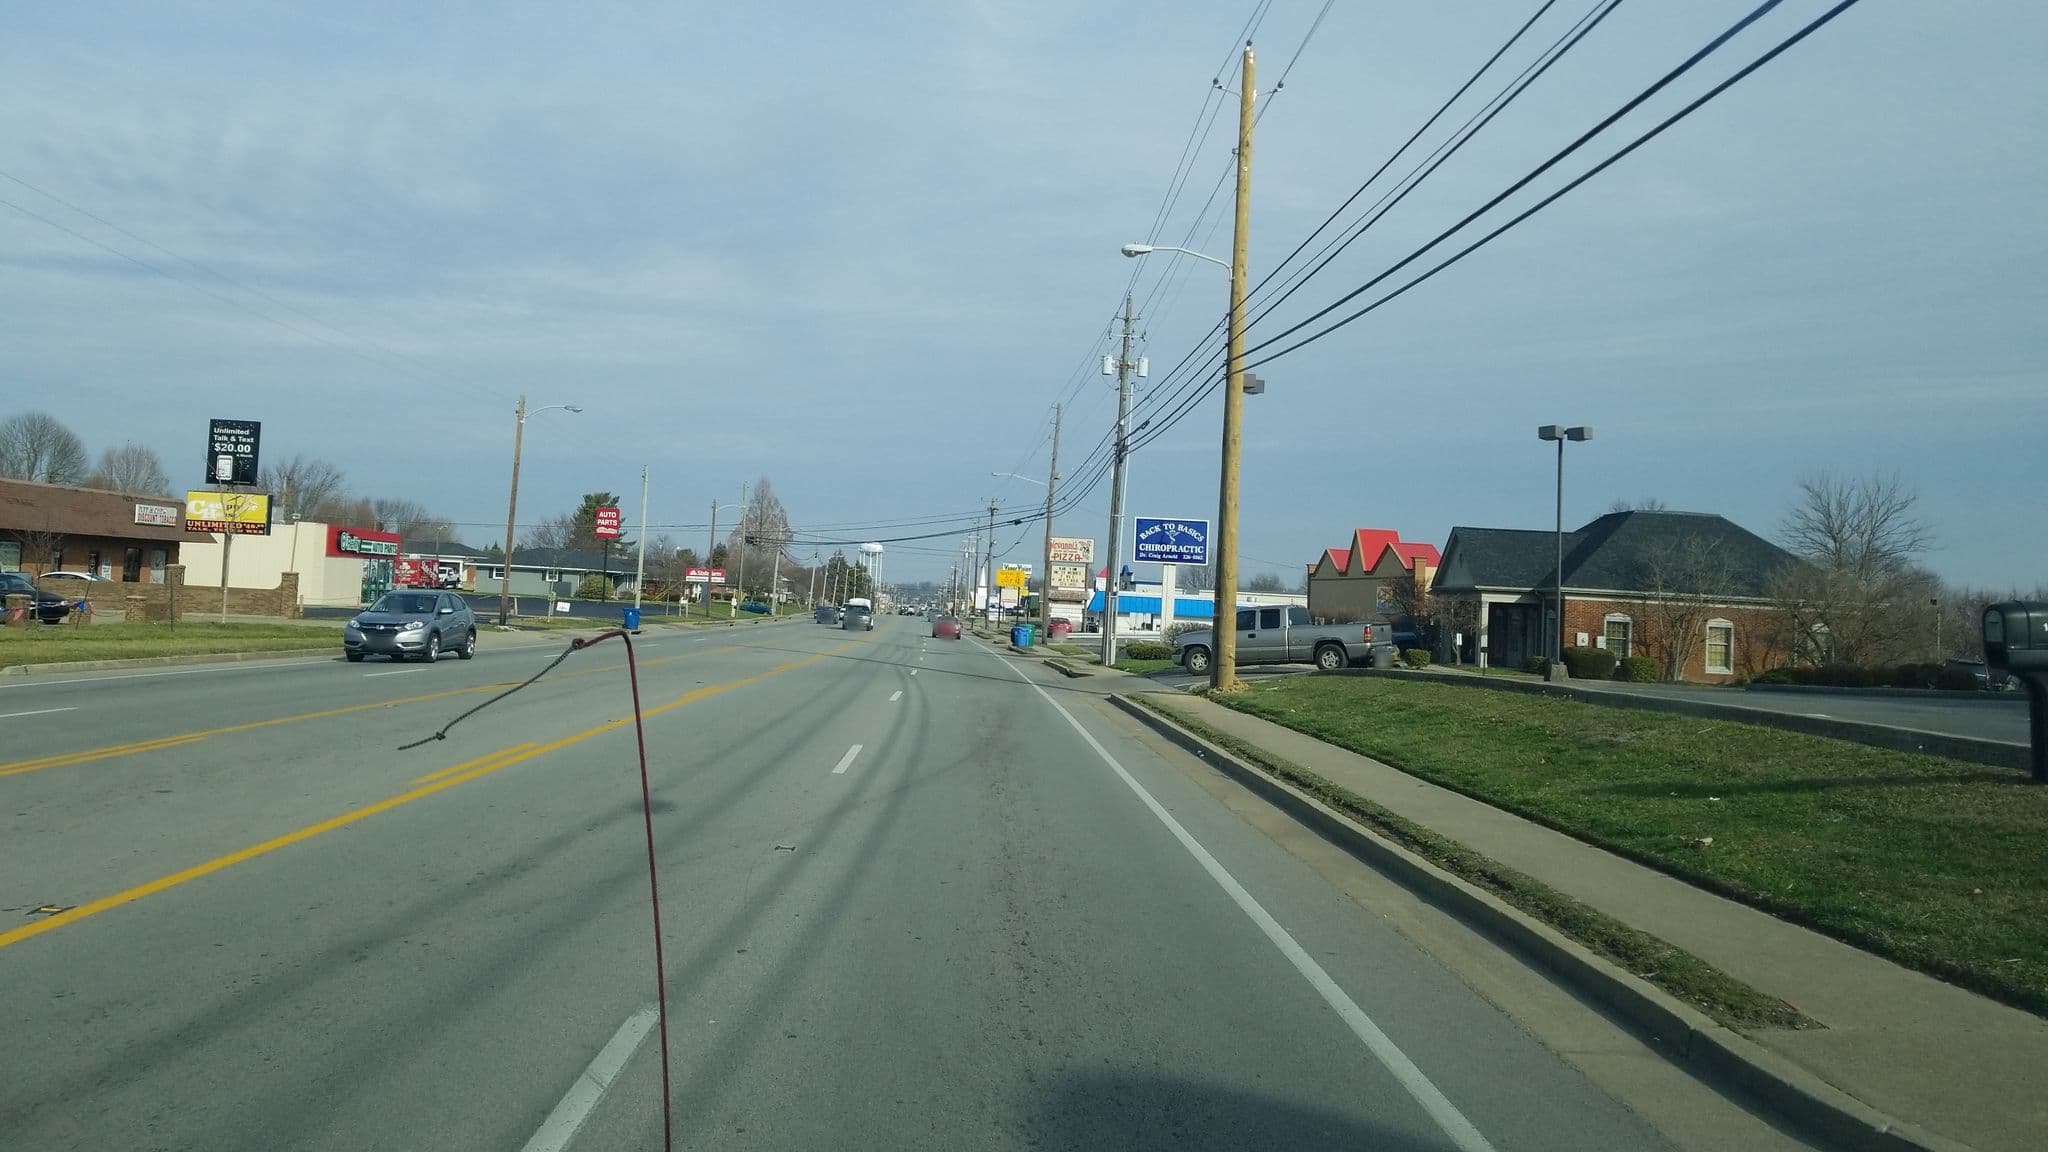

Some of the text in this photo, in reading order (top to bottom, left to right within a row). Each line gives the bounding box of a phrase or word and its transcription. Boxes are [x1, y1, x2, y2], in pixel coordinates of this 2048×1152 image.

[213, 427, 250, 436] Unlimited
[213, 434, 228, 442] Talk
[214, 443, 251, 452] $20.00
[597, 518, 618, 527] PARTS
[1140, 525, 1162, 540] BACK
[1177, 524, 1205, 542] BASICS
[1139, 543, 1204, 554] CHIROPRACTIC
[1053, 552, 1081, 562] PIZZA
